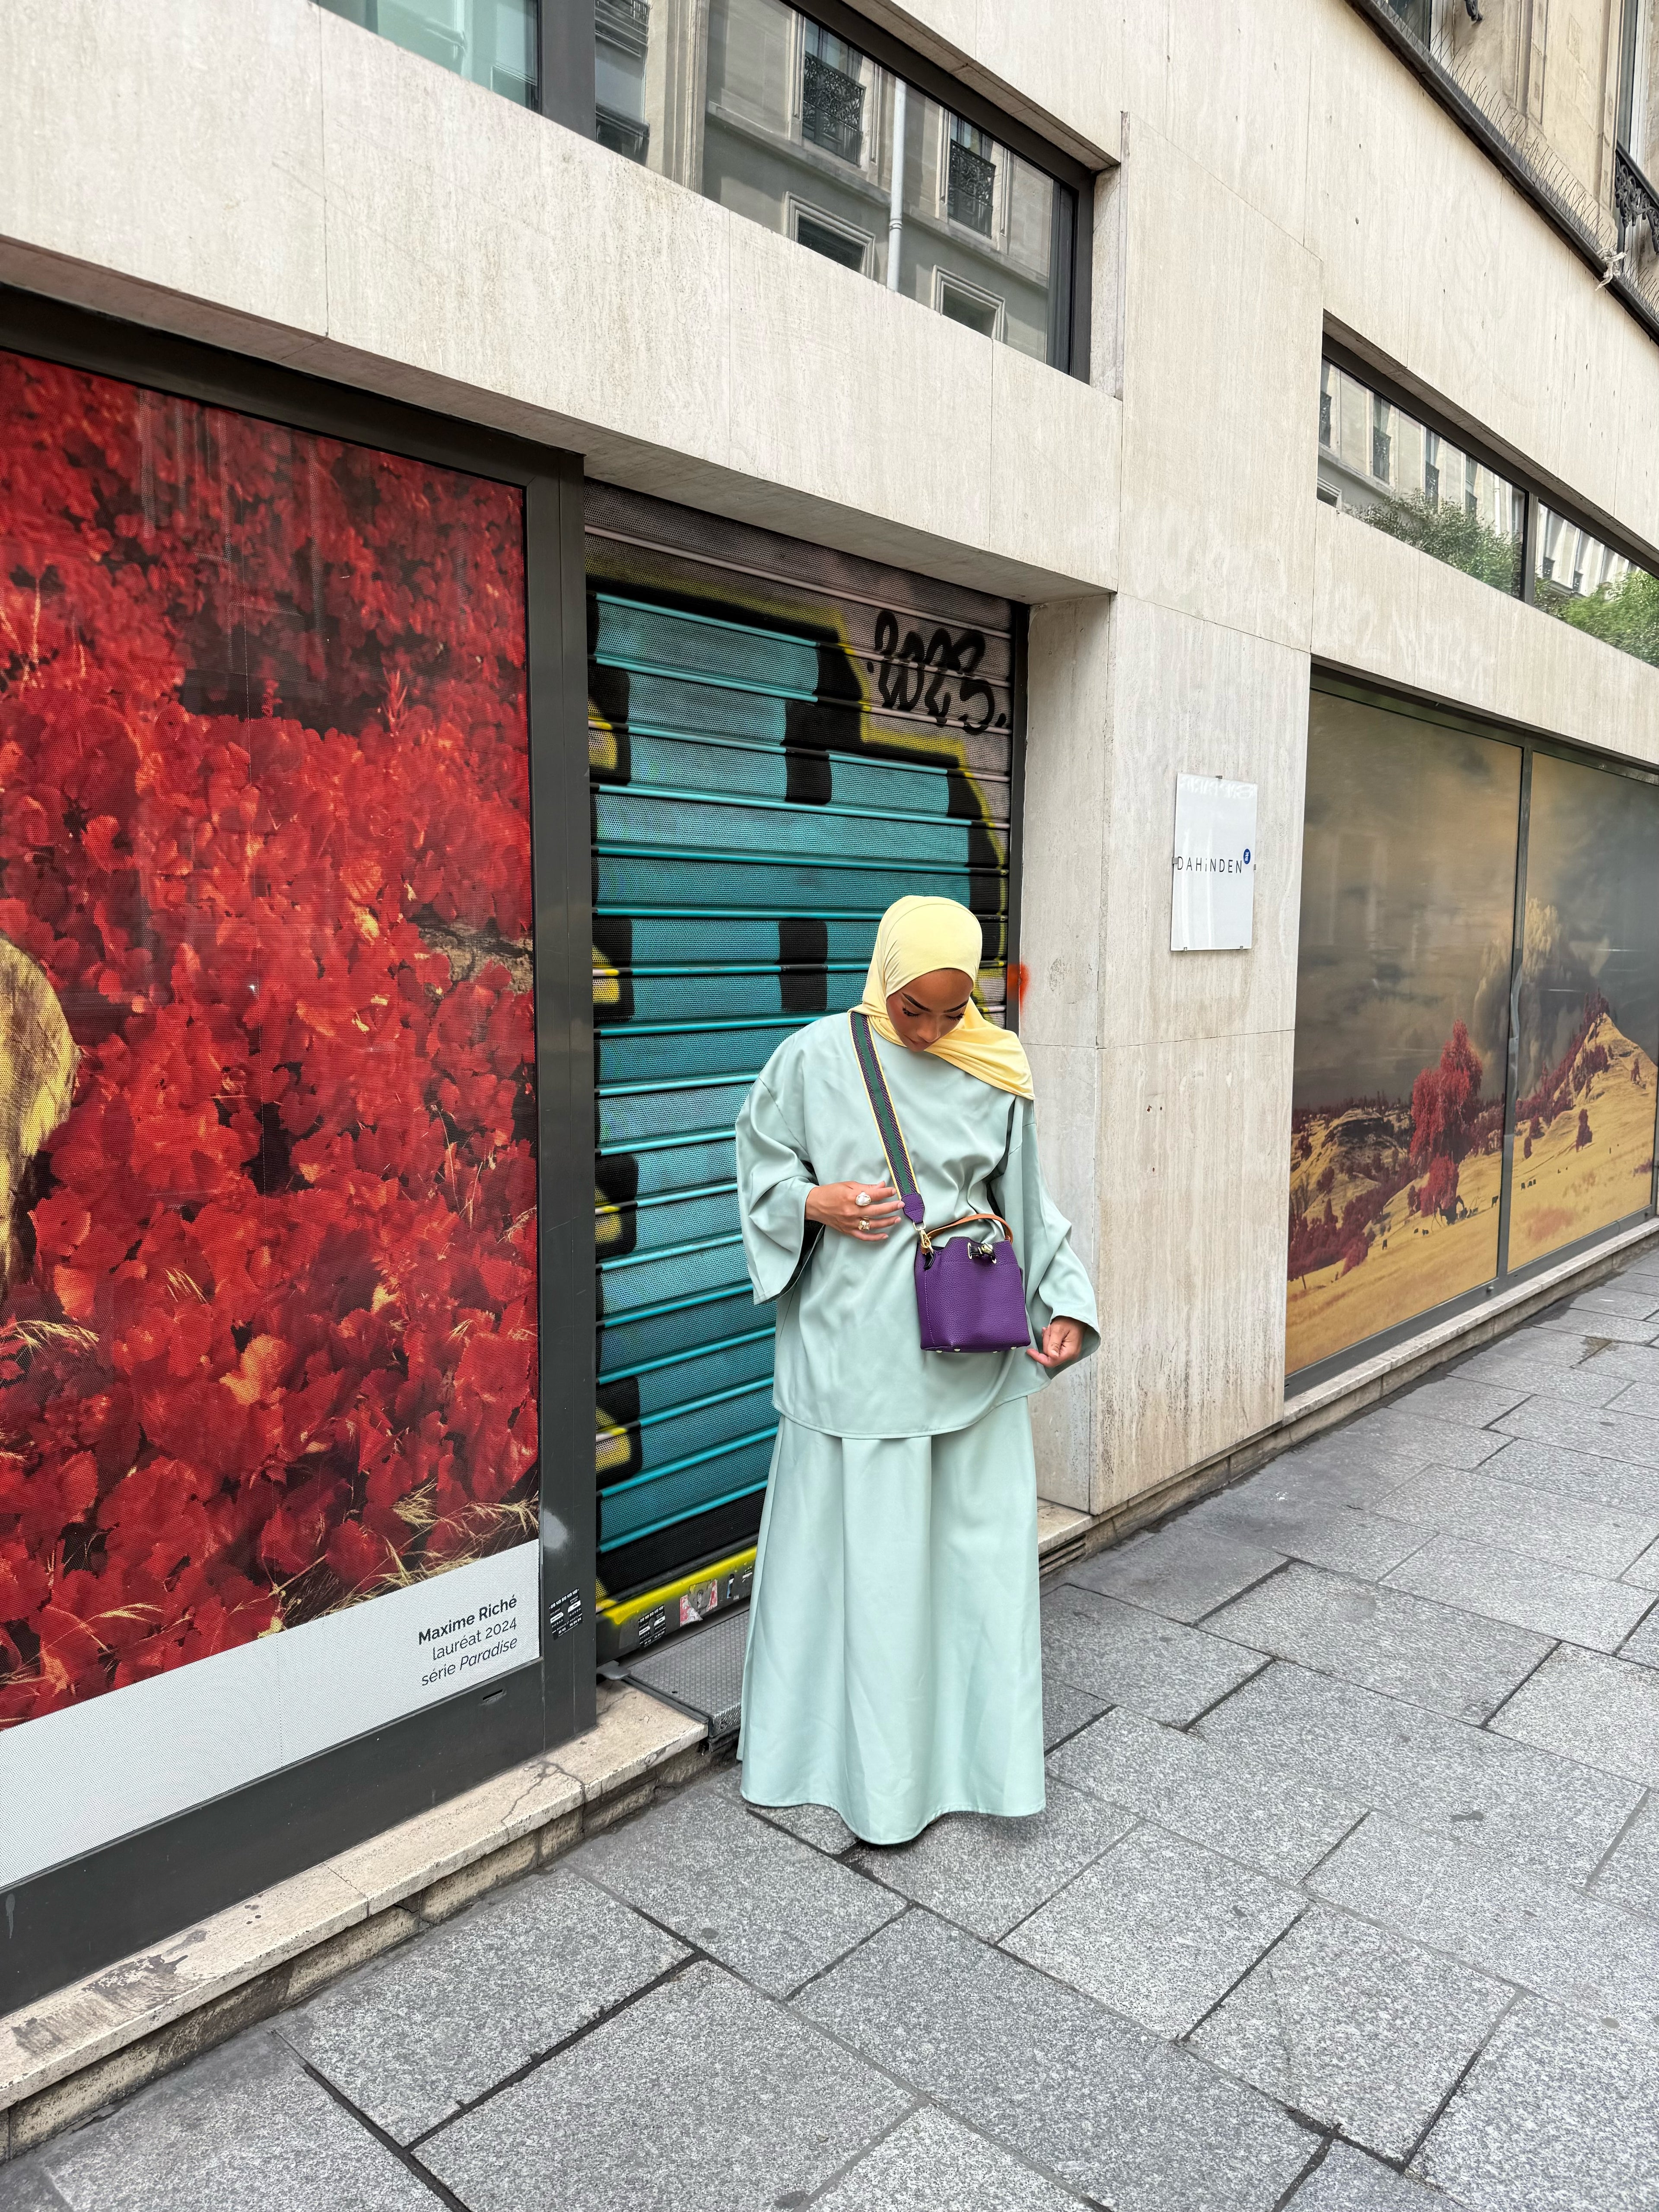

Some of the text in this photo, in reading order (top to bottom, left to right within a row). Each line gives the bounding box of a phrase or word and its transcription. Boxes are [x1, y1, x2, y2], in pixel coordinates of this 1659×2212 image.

[418, 1594, 517, 1645] Maxime Riché
[433, 1618, 517, 1660] lauréat 2024
[422, 1637, 518, 1686] série Paradise
